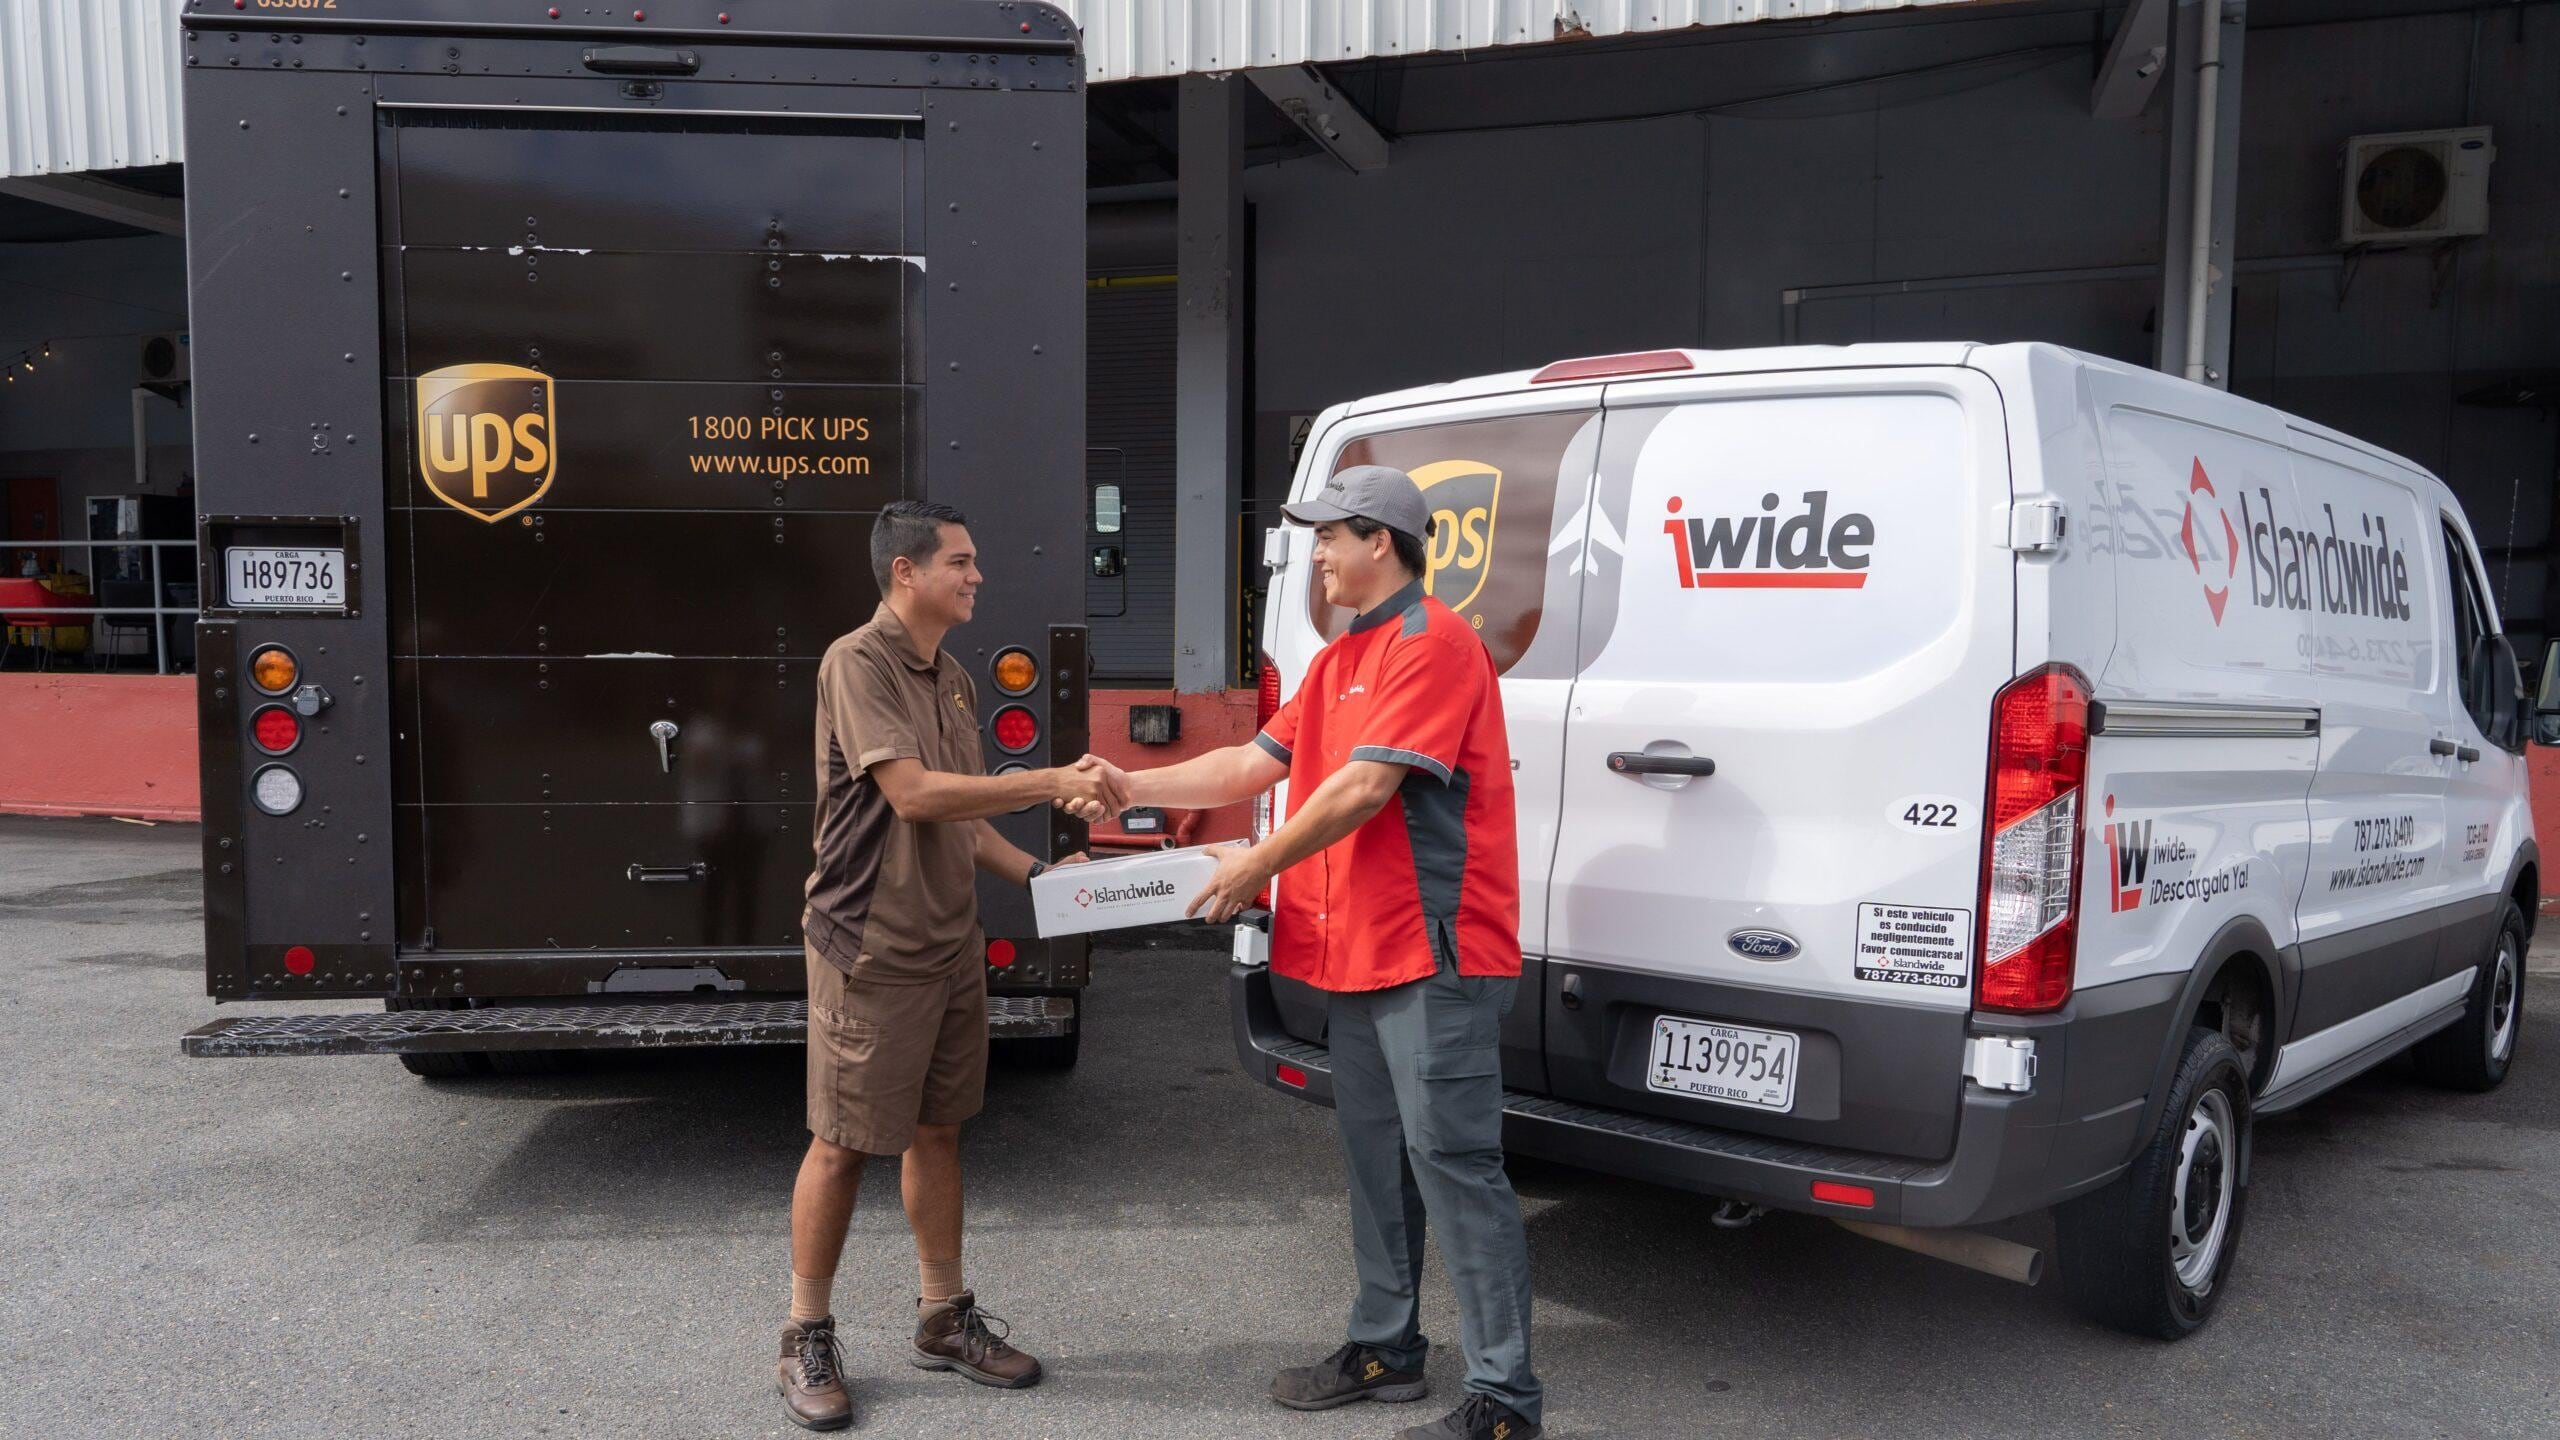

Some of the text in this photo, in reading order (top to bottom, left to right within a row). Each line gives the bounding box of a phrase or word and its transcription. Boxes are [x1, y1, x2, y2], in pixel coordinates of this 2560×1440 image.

[688, 415, 869, 441] 1800 PICK UPS
[428, 412, 549, 498] ups
[690, 452, 870, 480] www.ups.com
[1663, 490, 1875, 588] iwide
[275, 551, 299, 559] CARGA
[1423, 507, 1487, 596] ps
[2239, 487, 2411, 622] Islandwide
[243, 560, 333, 590] H89736
[264, 595, 314, 603] PUERTO RICO
[1904, 803, 1958, 827] 422
[2354, 815, 2414, 852] 787.273.6400
[2233, 864, 2249, 890] Ya!
[2329, 853, 2425, 892] www.islandwide.com
[1094, 880, 1175, 904] Islandwide
[1873, 907, 1883, 917] Si
[1887, 909, 1908, 919] este
[1870, 932, 1955, 946] negligentemente
[1880, 921, 1947, 934] es conducido
[1741, 935, 1782, 955] Ford
[1861, 943, 1963, 961] Favor comunicarse al
[1893, 958, 1945, 971] Islandwide
[1862, 968, 1959, 987] 787-273-6400
[1710, 1027, 1739, 1040] CARGA
[1660, 1031, 1787, 1086] 1139954
[1690, 1082, 1725, 1095] PUERTO
[1727, 1086, 1748, 1099] RICO
